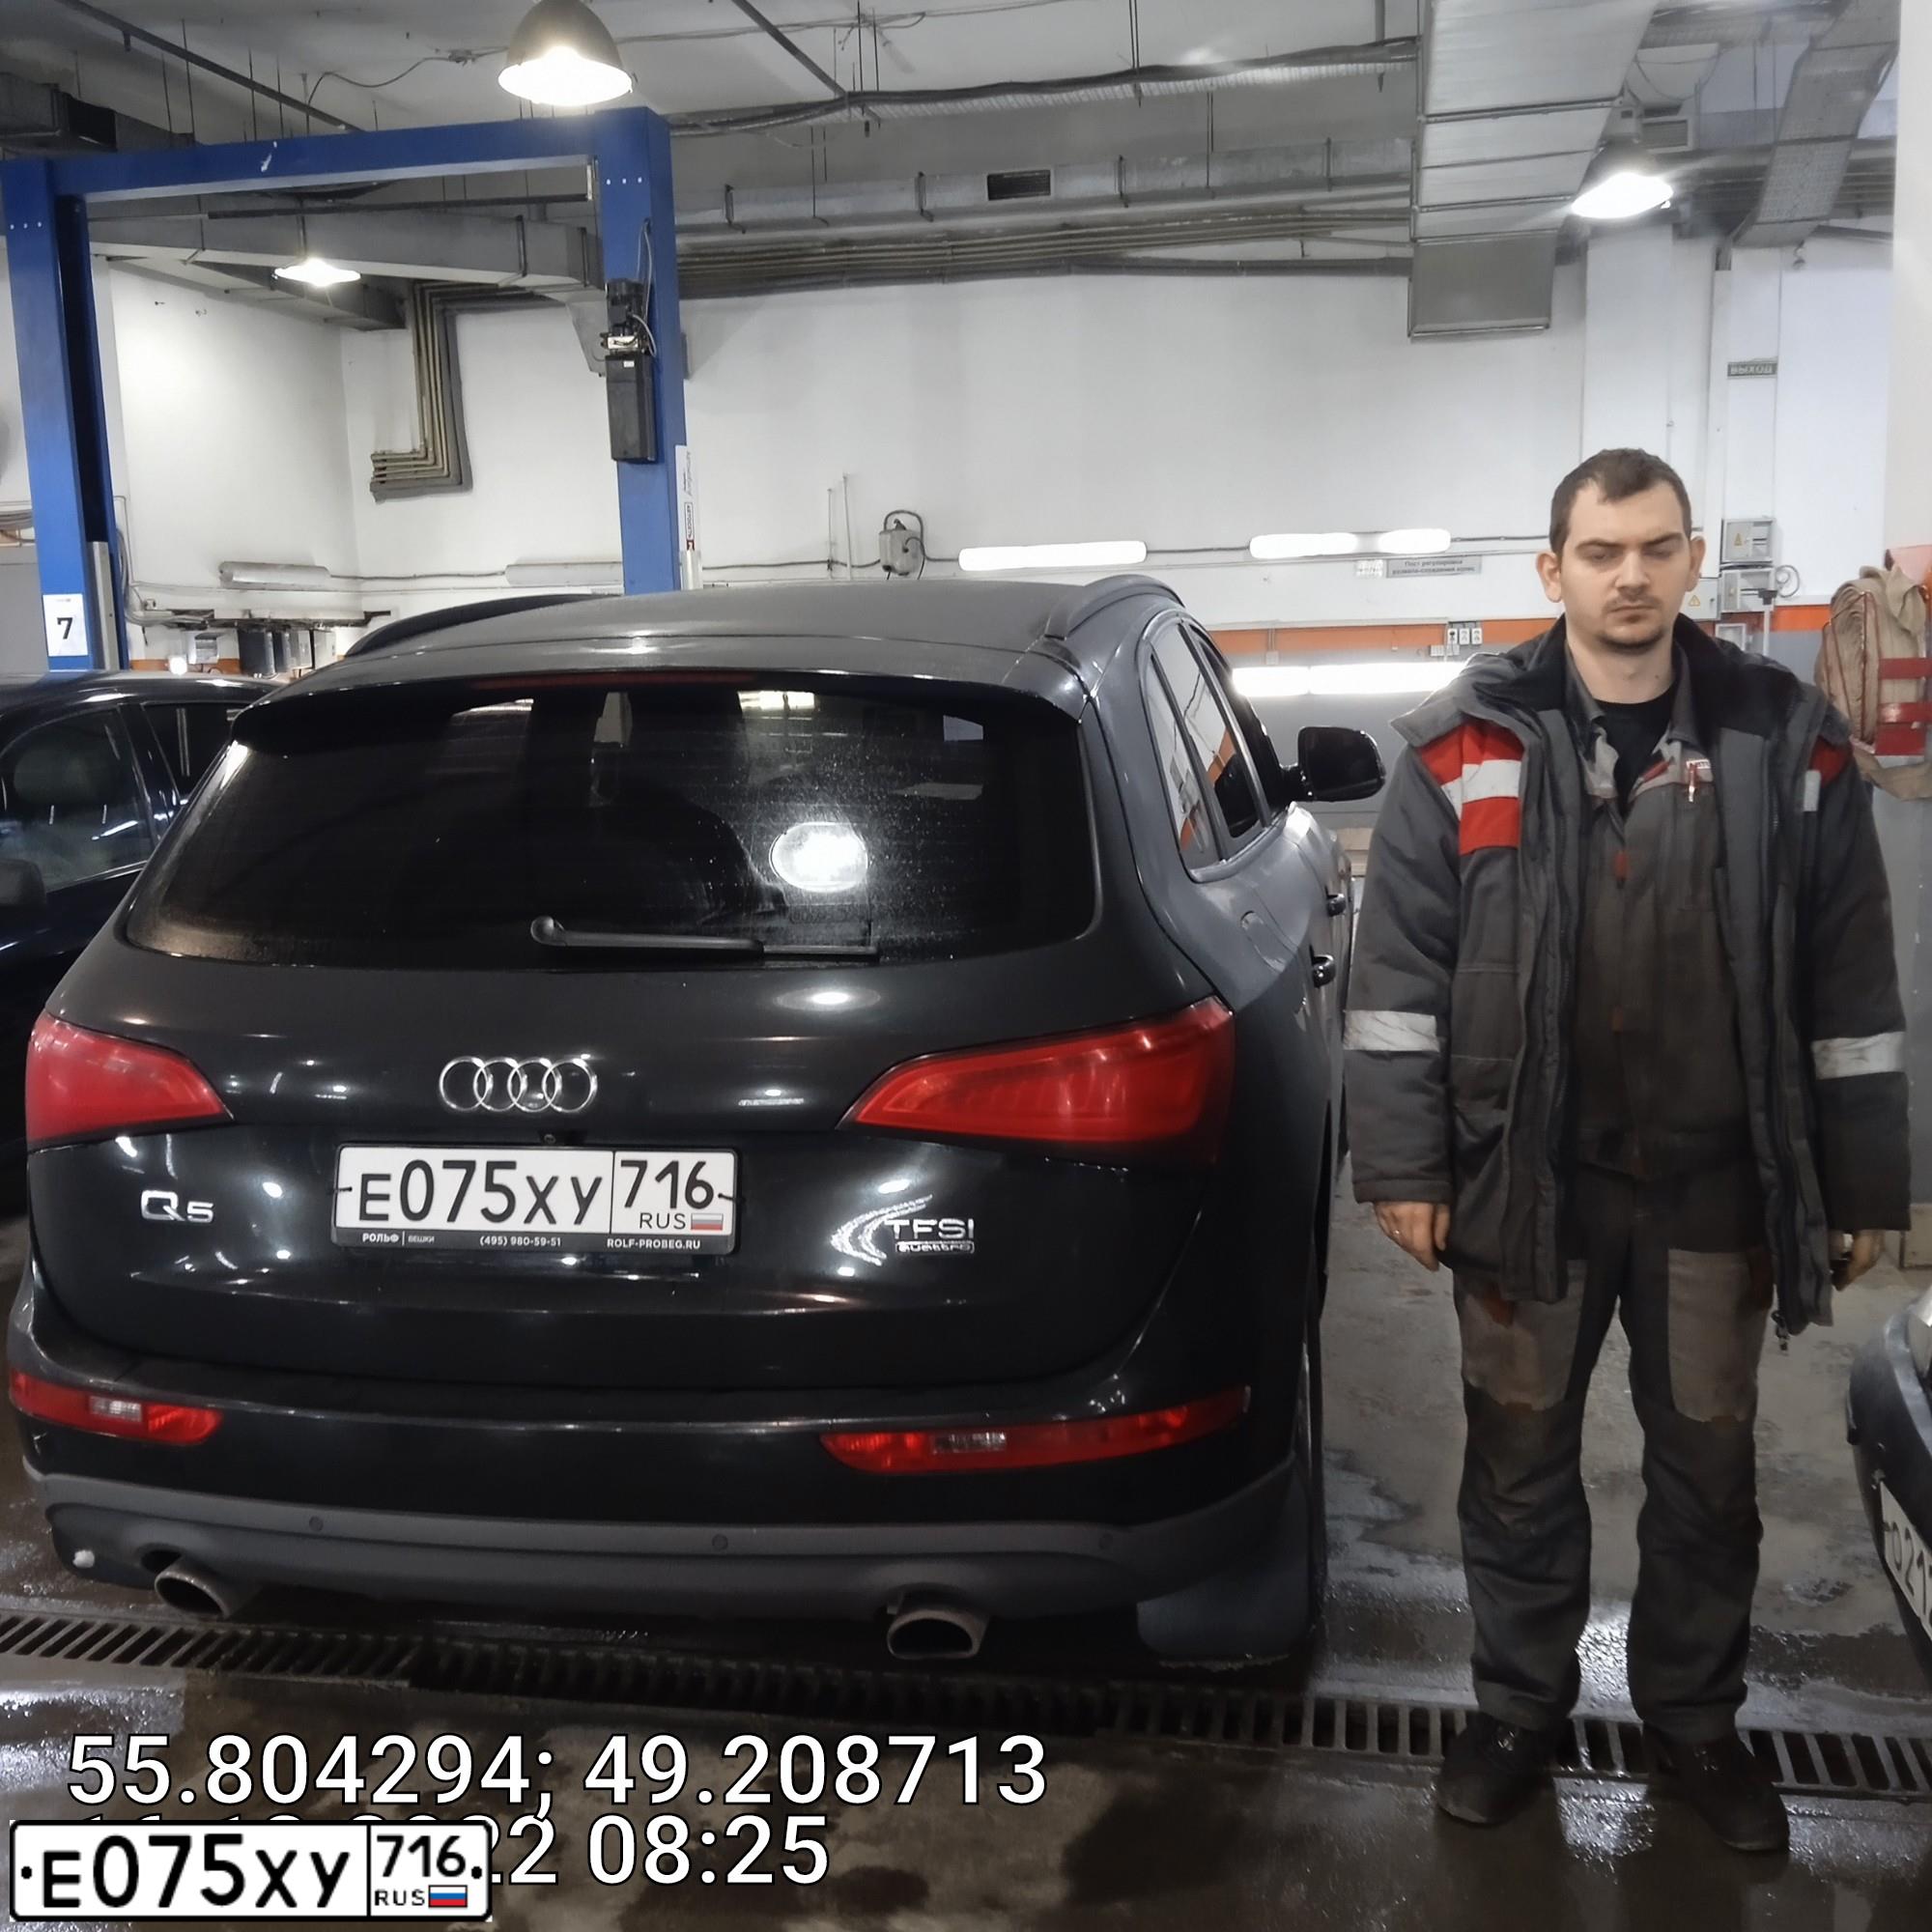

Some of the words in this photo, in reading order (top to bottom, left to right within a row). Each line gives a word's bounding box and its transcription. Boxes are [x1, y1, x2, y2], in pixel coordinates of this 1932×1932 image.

[57, 617, 73, 639] 7
[620, 1159, 715, 1209] 716
[141, 1189, 214, 1224] Q5
[639, 1212, 687, 1230] RUS
[883, 1218, 975, 1239] TFSI
[361, 1233, 399, 1244] РОЛЬФ
[479, 1236, 508, 1247] (495)
[510, 1236, 561, 1248] 980-59-51
[607, 1237, 701, 1250] ROLF-PROBEG.RU
